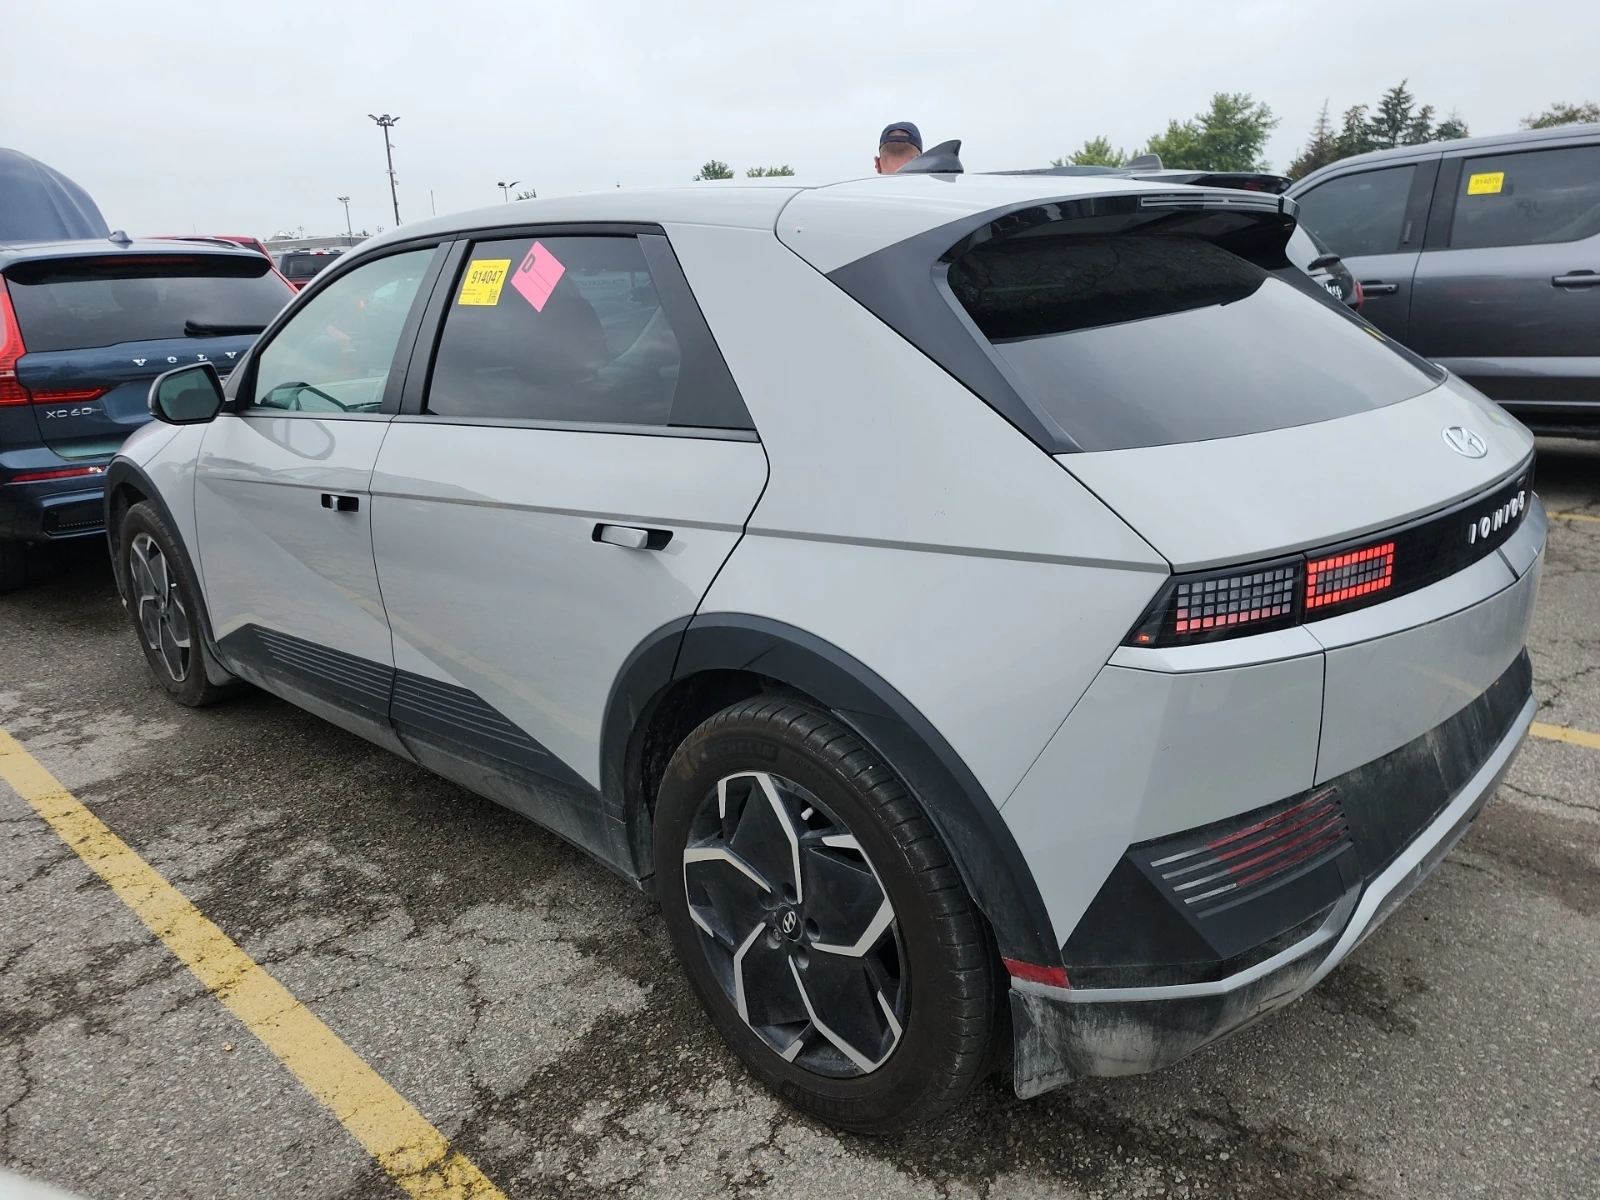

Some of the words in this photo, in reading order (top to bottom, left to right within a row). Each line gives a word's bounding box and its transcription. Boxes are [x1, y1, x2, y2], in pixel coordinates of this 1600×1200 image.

[521, 252, 537, 274] D
[471, 270, 503, 284] 914047
[132, 351, 238, 367] VOLV
[702, 741, 775, 760] ICHELIN
